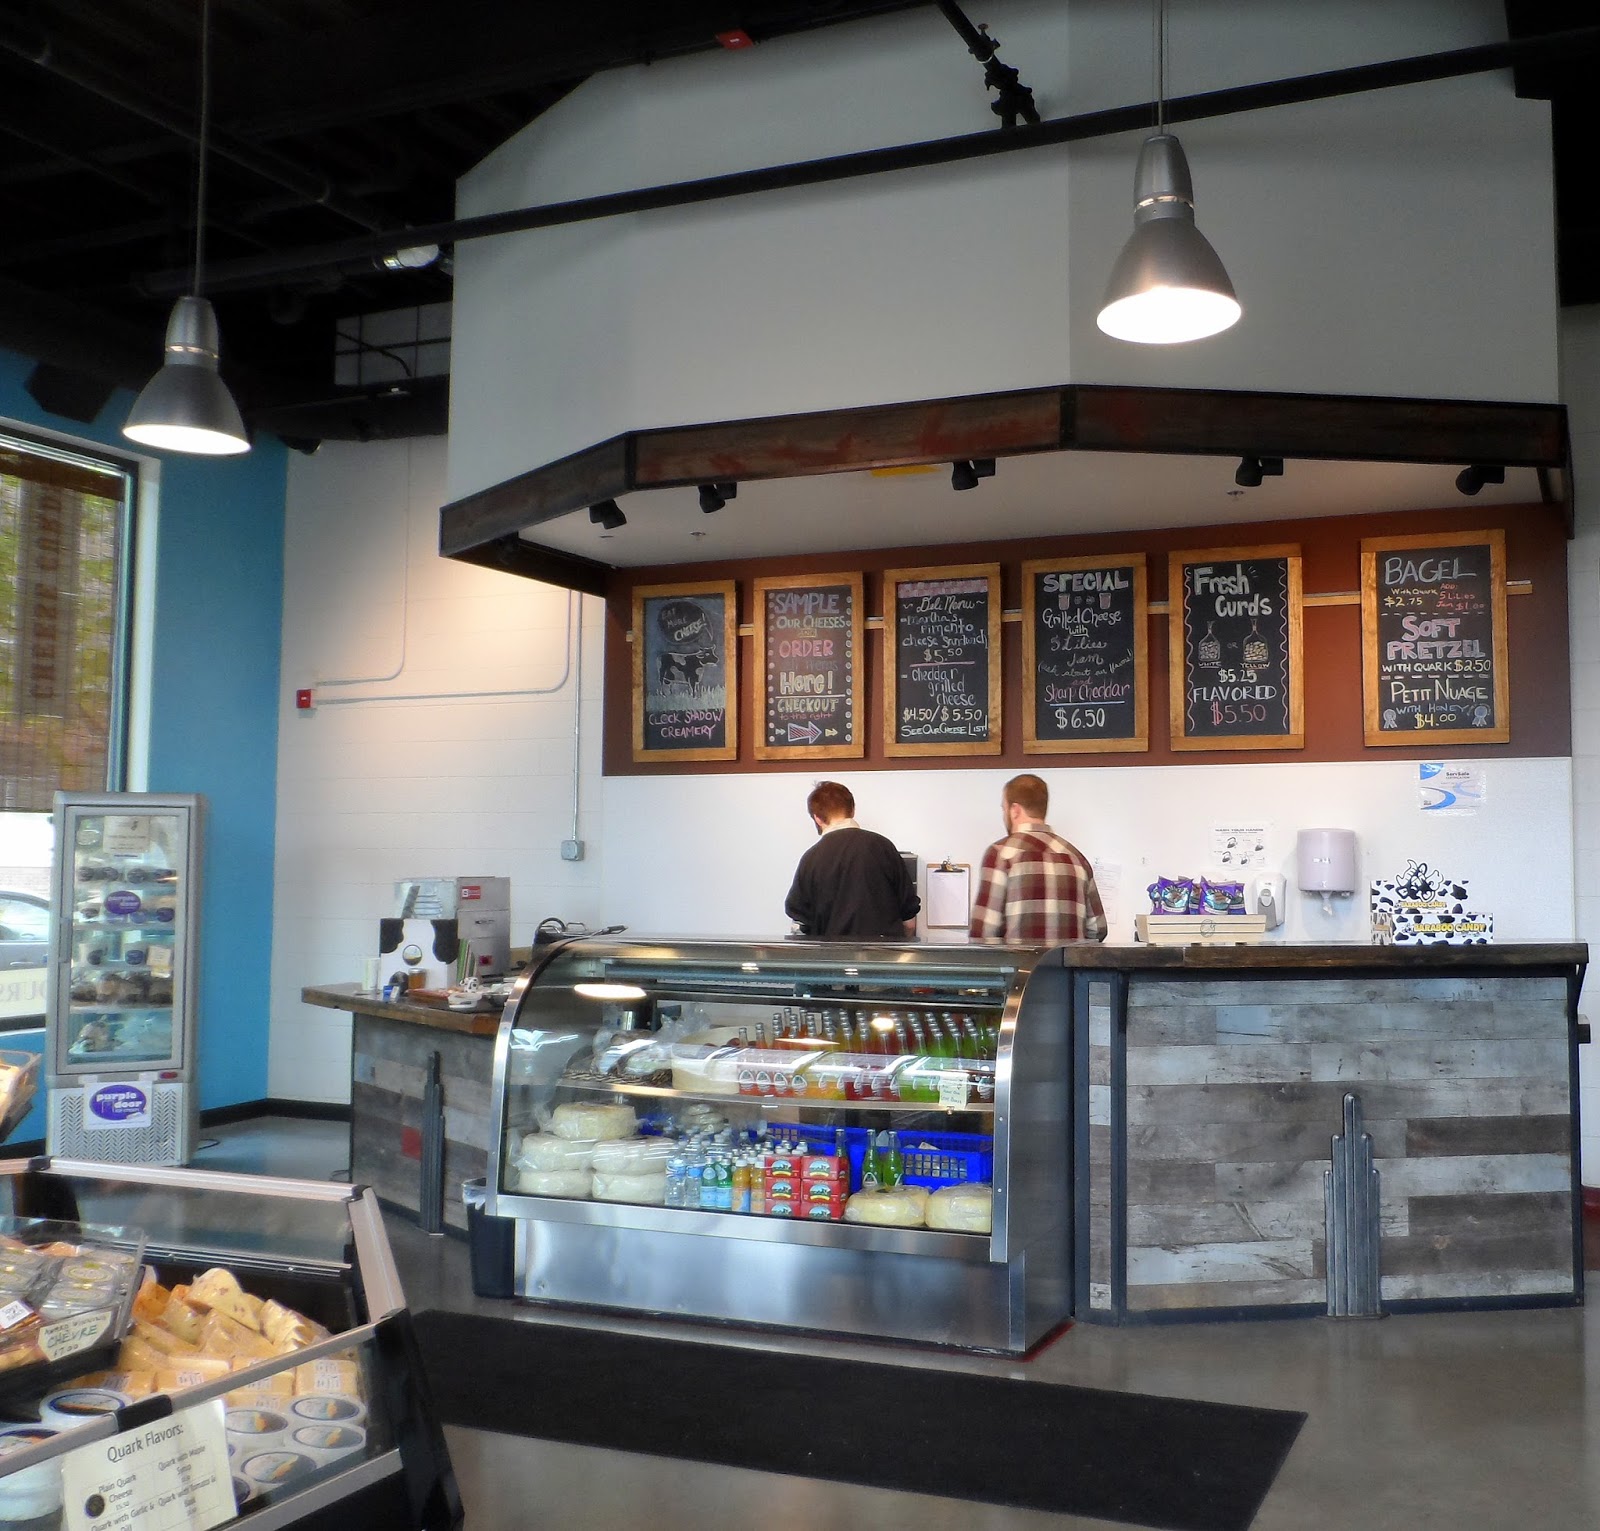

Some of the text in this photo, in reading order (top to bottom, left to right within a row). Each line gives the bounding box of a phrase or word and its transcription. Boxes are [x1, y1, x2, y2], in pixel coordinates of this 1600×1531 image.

[1193, 563, 1250, 596] Fresh
[1384, 557, 1477, 585] BAGEL
[1043, 570, 1129, 593] SPECIAL
[774, 592, 840, 615] SAMPLE
[1214, 593, 1273, 618] Curds
[1383, 596, 1423, 608] $2.75
[1401, 615, 1461, 641] SOFT
[779, 639, 834, 658] ORDER
[1386, 639, 1486, 661] PRETZEL
[1217, 668, 1258, 683] $5.25
[1381, 659, 1491, 672] WITH QUARK $2.50
[928, 673, 965, 697] grilled
[1193, 685, 1277, 703] FLAVORED
[1434, 677, 1489, 702] NUAGE
[777, 697, 840, 713] CHECKOUT
[1210, 701, 1267, 726] $5.50
[1396, 703, 1470, 714] WITH HONEY
[648, 705, 723, 726] CLOCK SHADOW
[1414, 712, 1457, 729] $4.00
[660, 723, 717, 740] CREAMERY
[1413, 922, 1487, 933] BARABOO CANDY
[96, 1091, 137, 1102] purple
[114, 1100, 143, 1108] door
[107, 1424, 184, 1463] Quark Flavors:
[98, 1474, 137, 1494] Plain Quark
